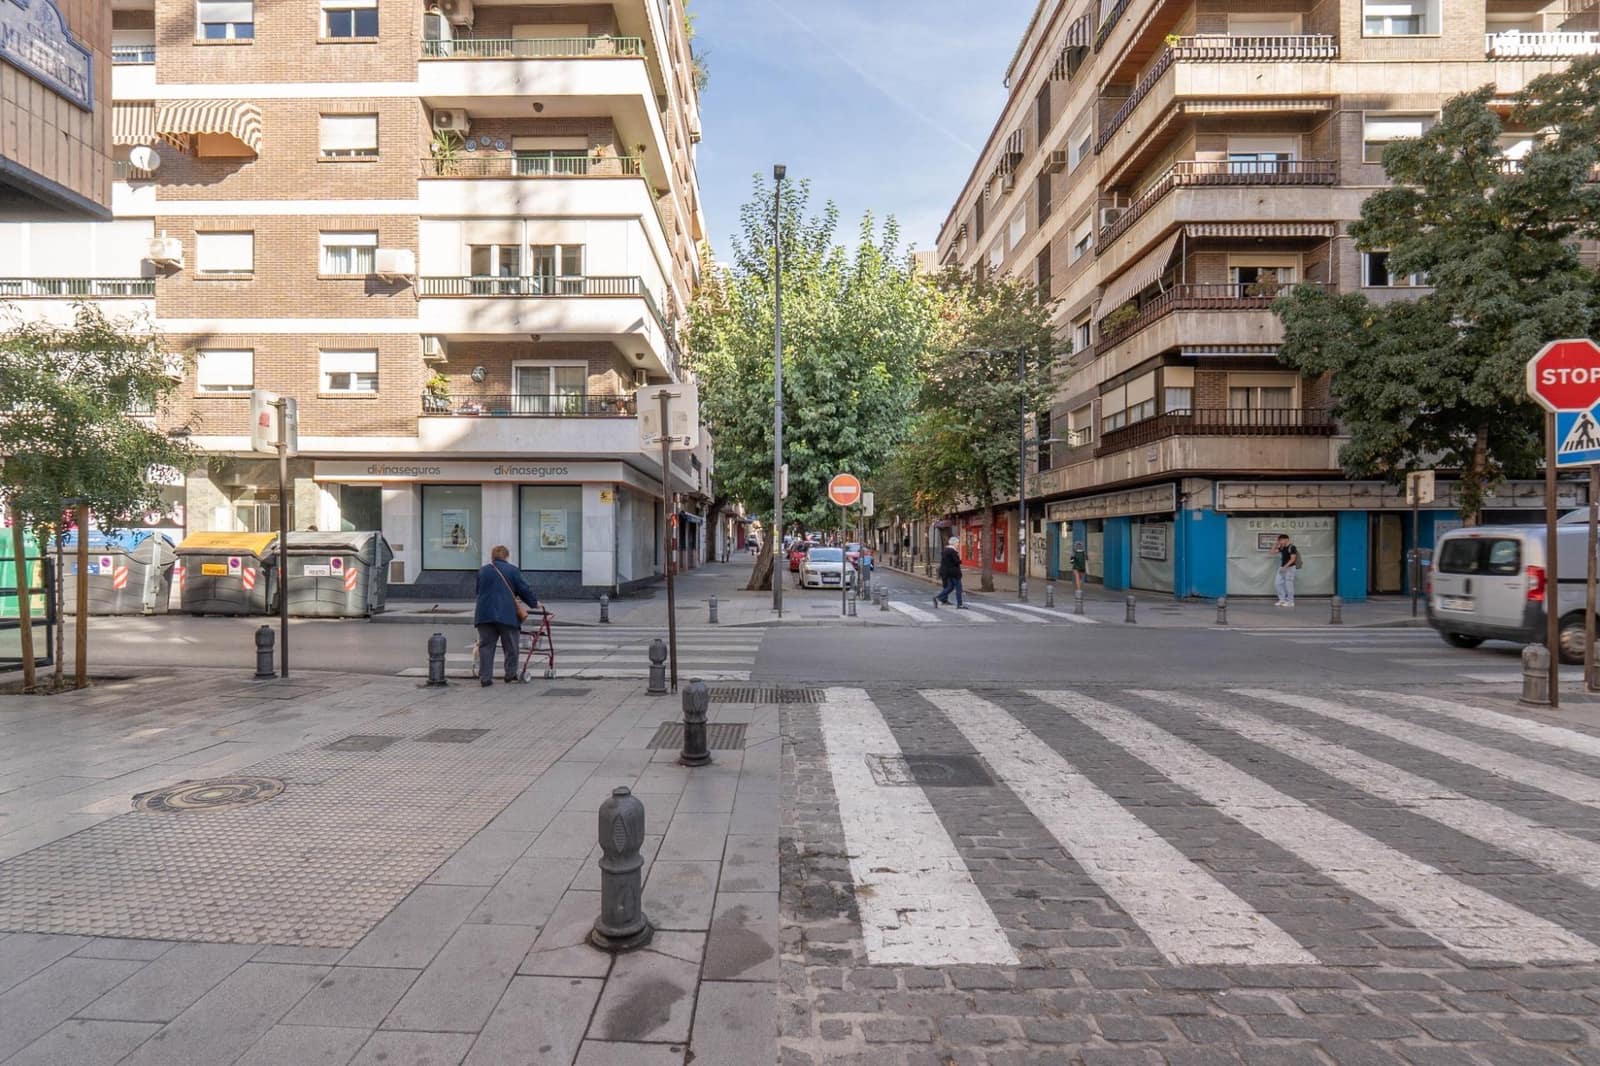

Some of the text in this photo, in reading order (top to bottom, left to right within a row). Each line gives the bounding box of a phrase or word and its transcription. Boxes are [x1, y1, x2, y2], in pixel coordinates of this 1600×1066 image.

[1542, 368, 1600, 384] STOP
[368, 465, 440, 476] divinaseguros
[494, 464, 568, 478] divinaseguros
[1249, 519, 1264, 528] SE
